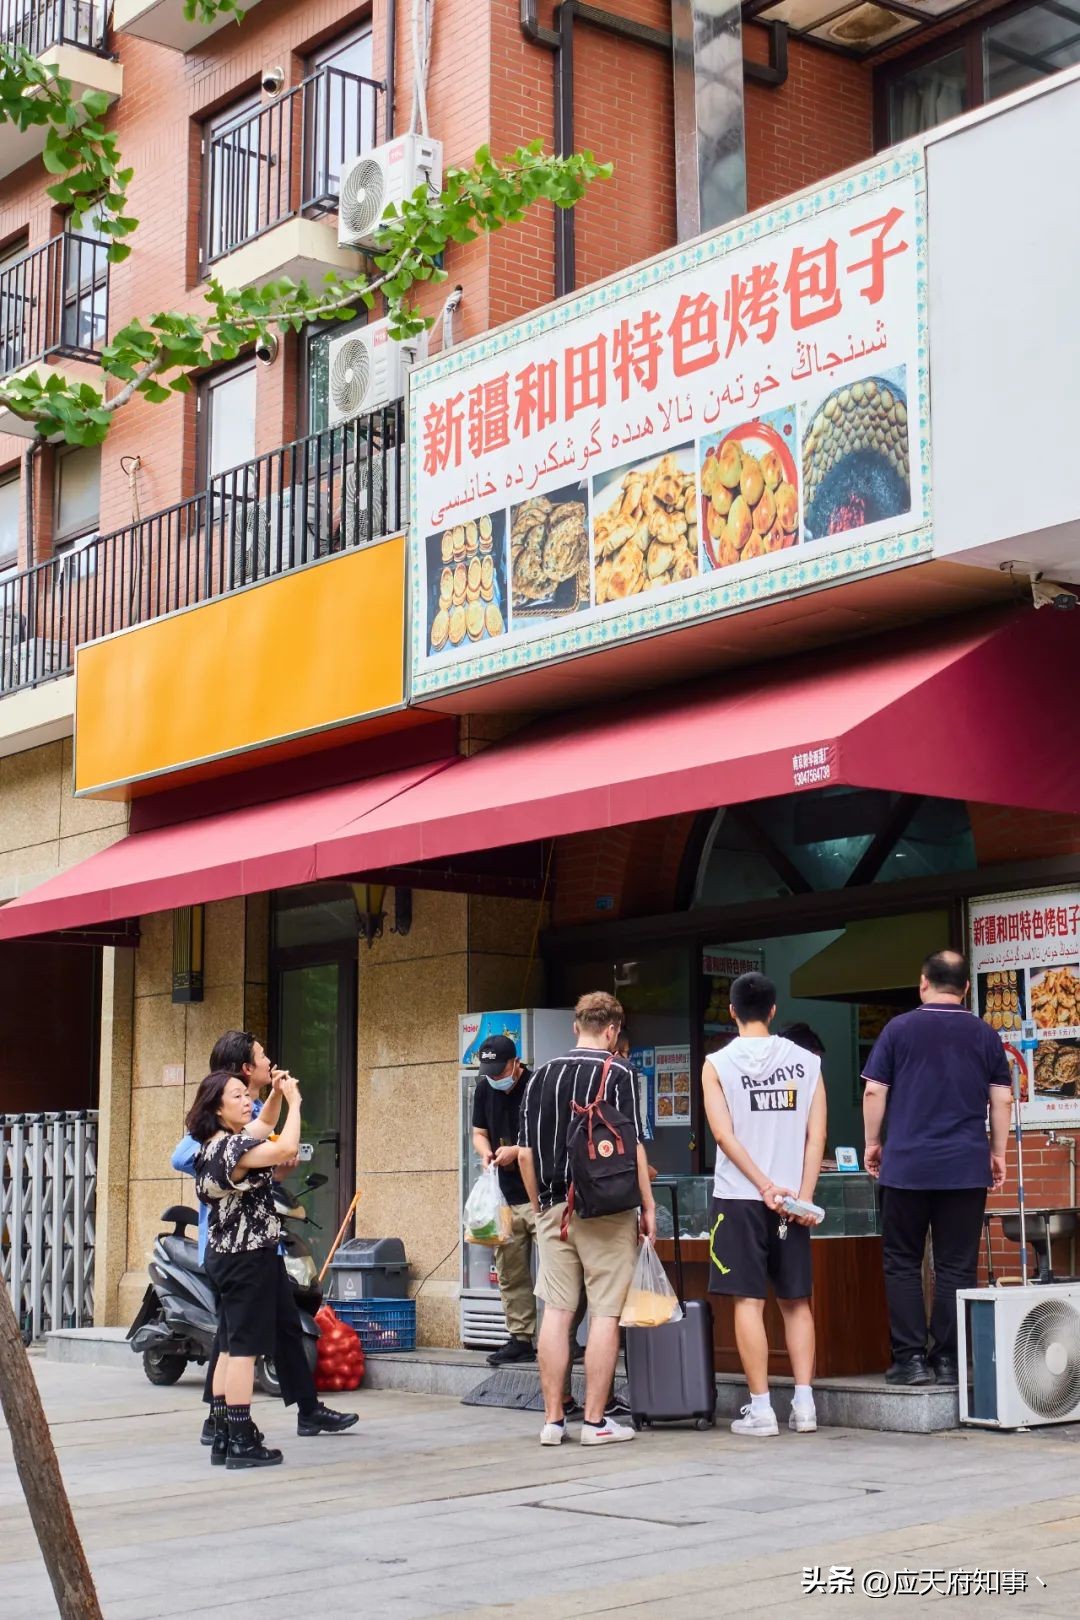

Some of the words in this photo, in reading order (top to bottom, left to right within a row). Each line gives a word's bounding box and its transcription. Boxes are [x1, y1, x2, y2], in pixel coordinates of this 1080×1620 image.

[422, 206, 909, 478] 新疆和田特色烤包子
[790, 319, 887, 381] شىنجاڭ
[703, 364, 780, 424] خوتەن
[973, 904, 1080, 947] 新疆和田特色烤包子
[462, 1023, 478, 1033] Haier
[753, 1090, 794, 1110] WIN!
